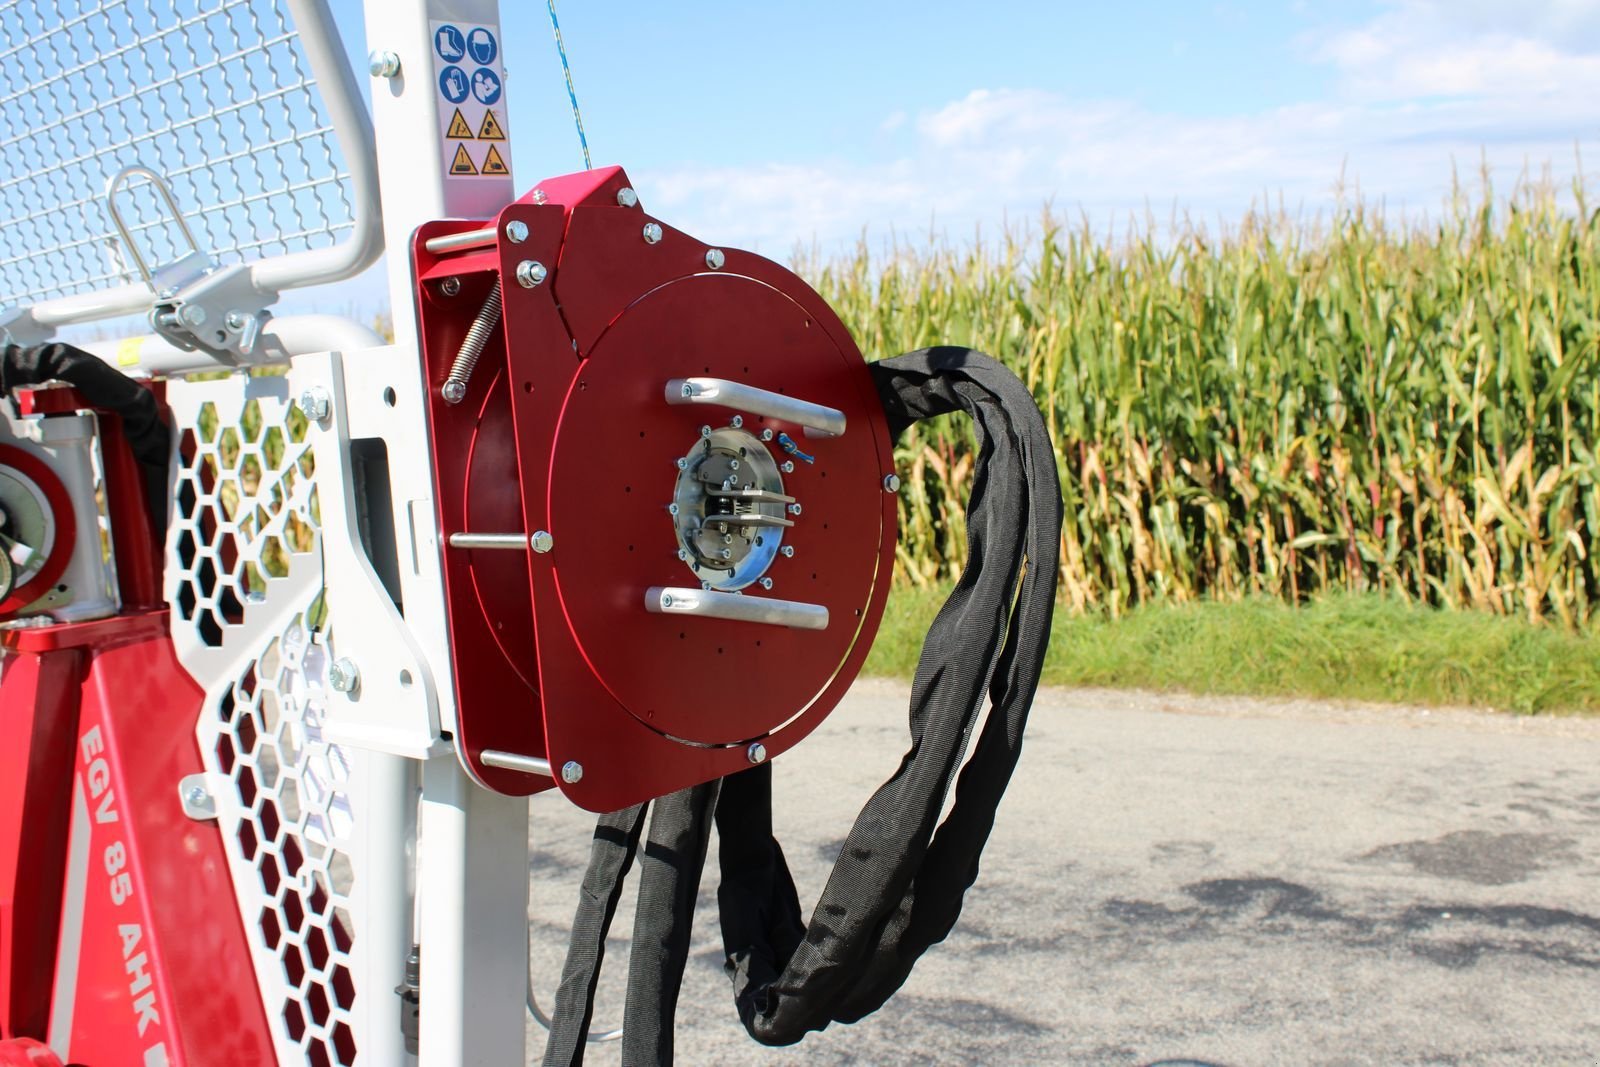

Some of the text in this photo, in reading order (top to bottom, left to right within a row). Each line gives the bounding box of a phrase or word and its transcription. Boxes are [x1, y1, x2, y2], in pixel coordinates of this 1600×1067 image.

[81, 724, 161, 1039] EGV 85 AHK
